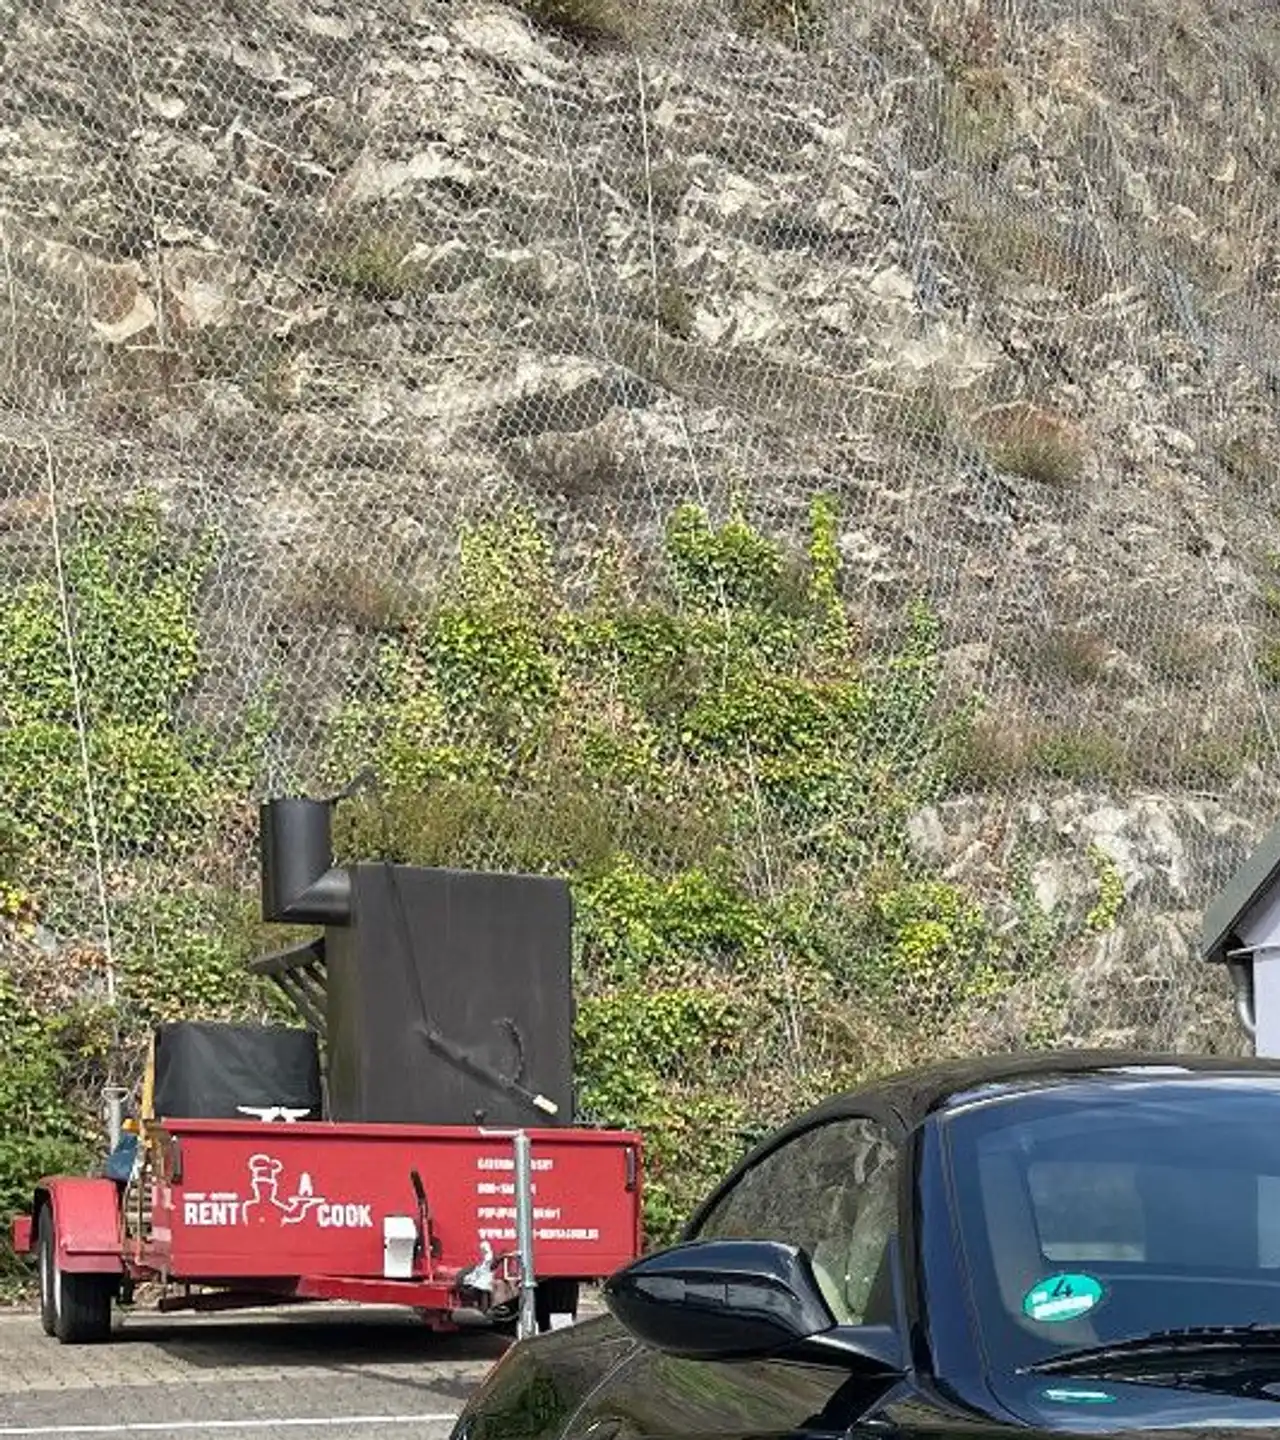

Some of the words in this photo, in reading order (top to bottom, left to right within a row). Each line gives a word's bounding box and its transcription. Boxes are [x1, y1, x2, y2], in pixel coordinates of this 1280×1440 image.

[184, 1202, 240, 1225] RENT
[299, 1172, 313, 1197] A
[317, 1204, 373, 1228] COOK
[1051, 1279, 1074, 1297] 4
